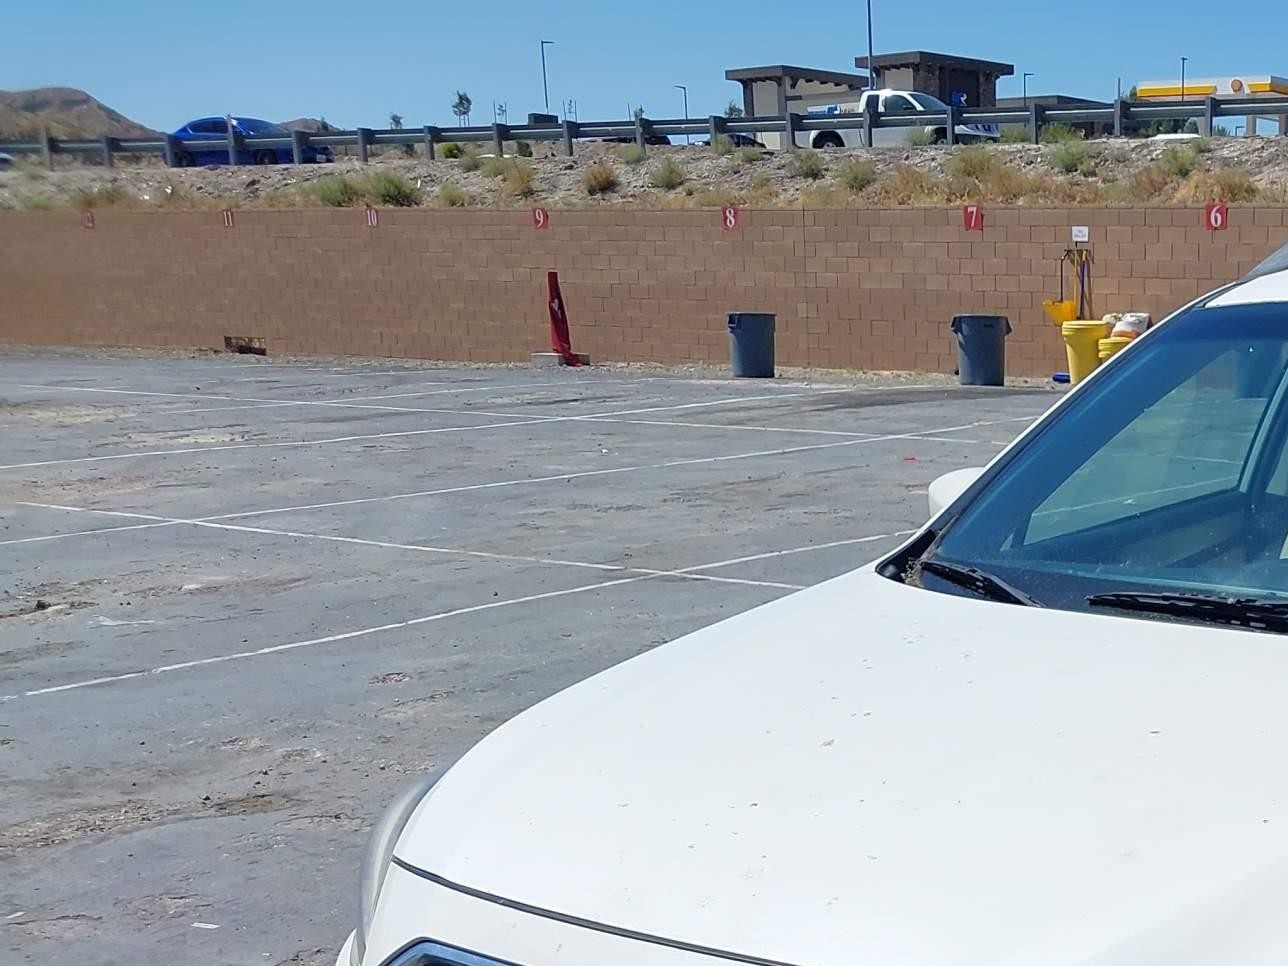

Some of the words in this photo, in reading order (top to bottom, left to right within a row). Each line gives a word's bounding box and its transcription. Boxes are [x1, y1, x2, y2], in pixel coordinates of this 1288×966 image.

[223, 211, 233, 227] 11
[366, 209, 377, 226] 10
[535, 208, 544, 228] 9
[726, 208, 735, 228] 8
[967, 206, 977, 228] 7
[1210, 204, 1222, 228] 6
